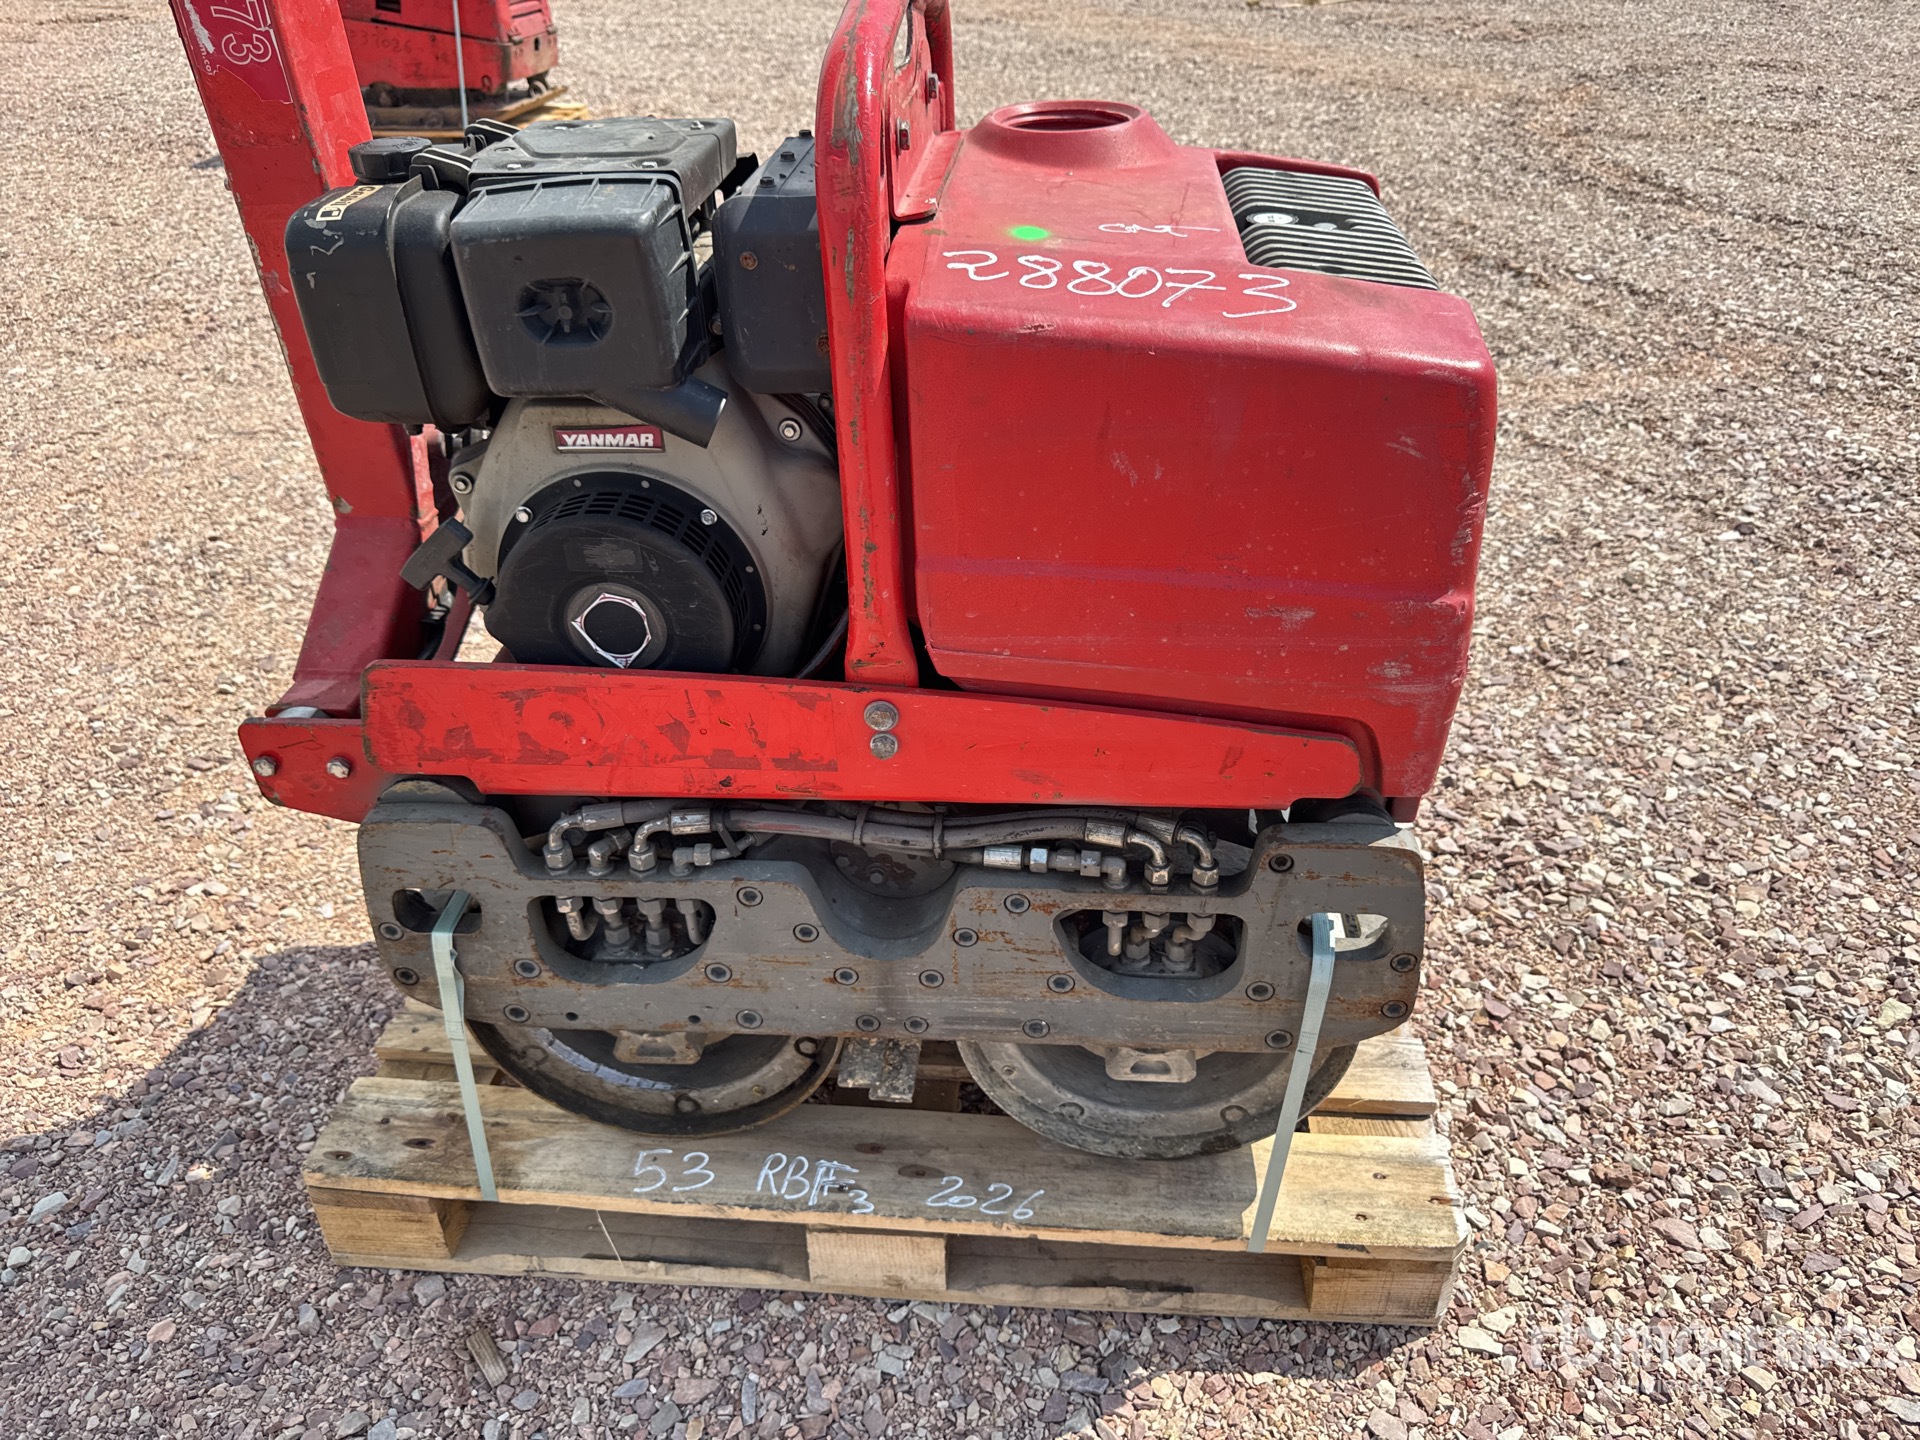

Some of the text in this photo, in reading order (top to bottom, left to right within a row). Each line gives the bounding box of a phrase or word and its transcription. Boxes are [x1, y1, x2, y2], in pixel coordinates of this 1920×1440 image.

[210, 0, 272, 65] 73
[943, 250, 1297, 318] 288073
[561, 432, 655, 448] YANMAR
[632, 1148, 716, 1193] 53
[925, 1175, 1045, 1220] 2026
